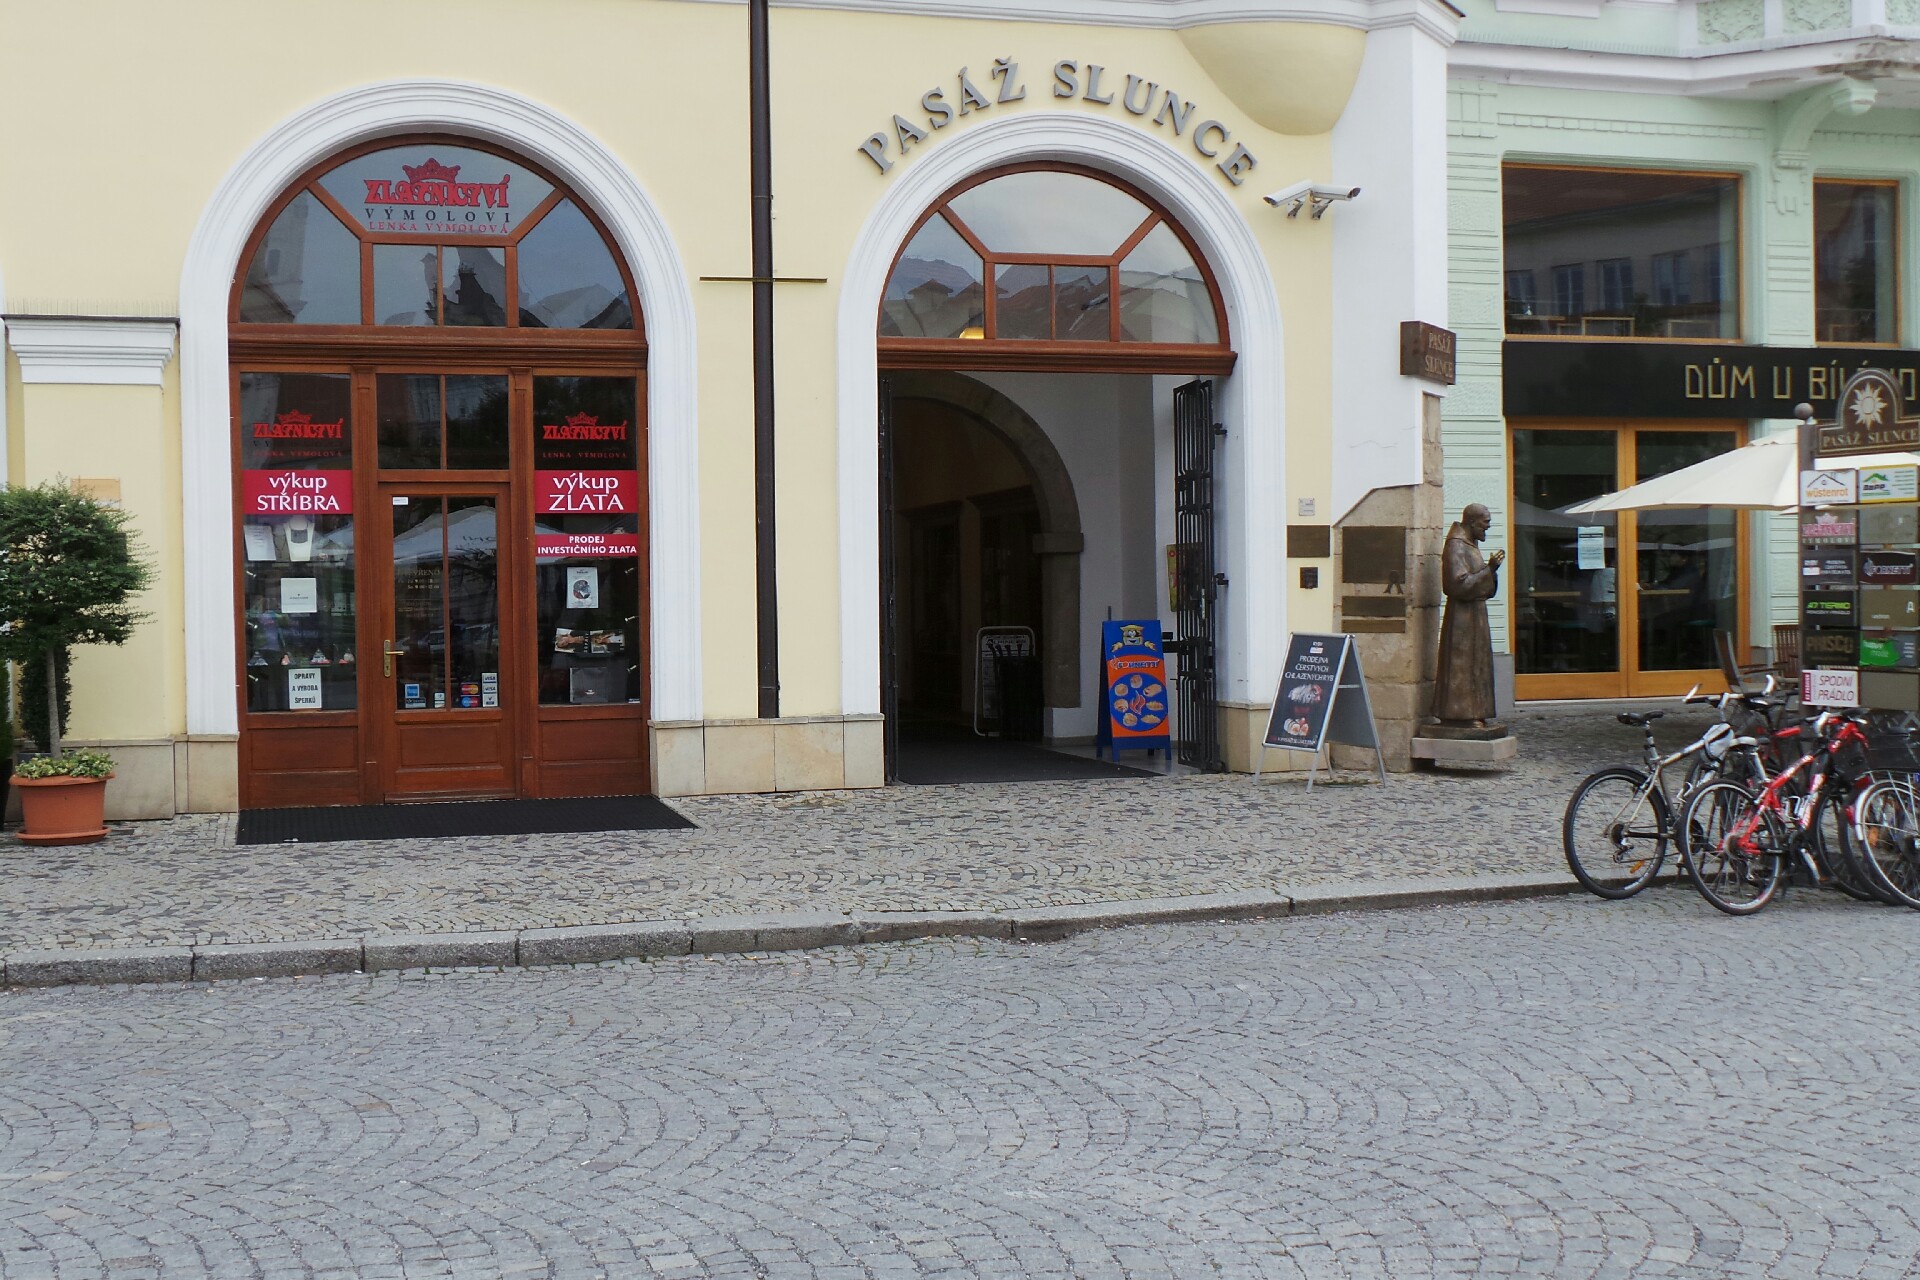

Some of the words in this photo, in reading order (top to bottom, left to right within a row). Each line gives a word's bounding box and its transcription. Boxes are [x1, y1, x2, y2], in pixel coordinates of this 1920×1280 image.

[858, 55, 1027, 175] PASÁŽ
[1053, 59, 1259, 186] SLUNCE
[364, 174, 511, 208] ZLATNICTVÍ
[365, 206, 510, 223] VÝMOLOVI
[369, 221, 417, 231] LENKA
[425, 222, 508, 234] VÝMOLOVÁ
[1685, 357, 1756, 399] DŮM
[1773, 366, 1791, 399] U
[253, 418, 344, 438] ZLATNICTVÍ
[543, 420, 628, 440] ZLATNICTVÍ
[1823, 431, 1860, 448] PASÁŽ
[1868, 428, 1918, 442] SLUNCE
[269, 472, 328, 495] výkup
[552, 472, 619, 494] výkup
[257, 492, 340, 511] STŘÍBRA
[548, 493, 625, 511] ZLATA
[1806, 488, 1849, 498] wüstenrot
[538, 543, 607, 554] INVESTIČNÍHO
[608, 545, 637, 554] ZLATA
[569, 536, 605, 544] PRODEJ
[1299, 655, 1329, 664] PRODEJNA
[294, 672, 316, 680] OPRAVY
[1819, 674, 1853, 687] SPODNÍ
[1818, 688, 1855, 701] PRÁDLO
